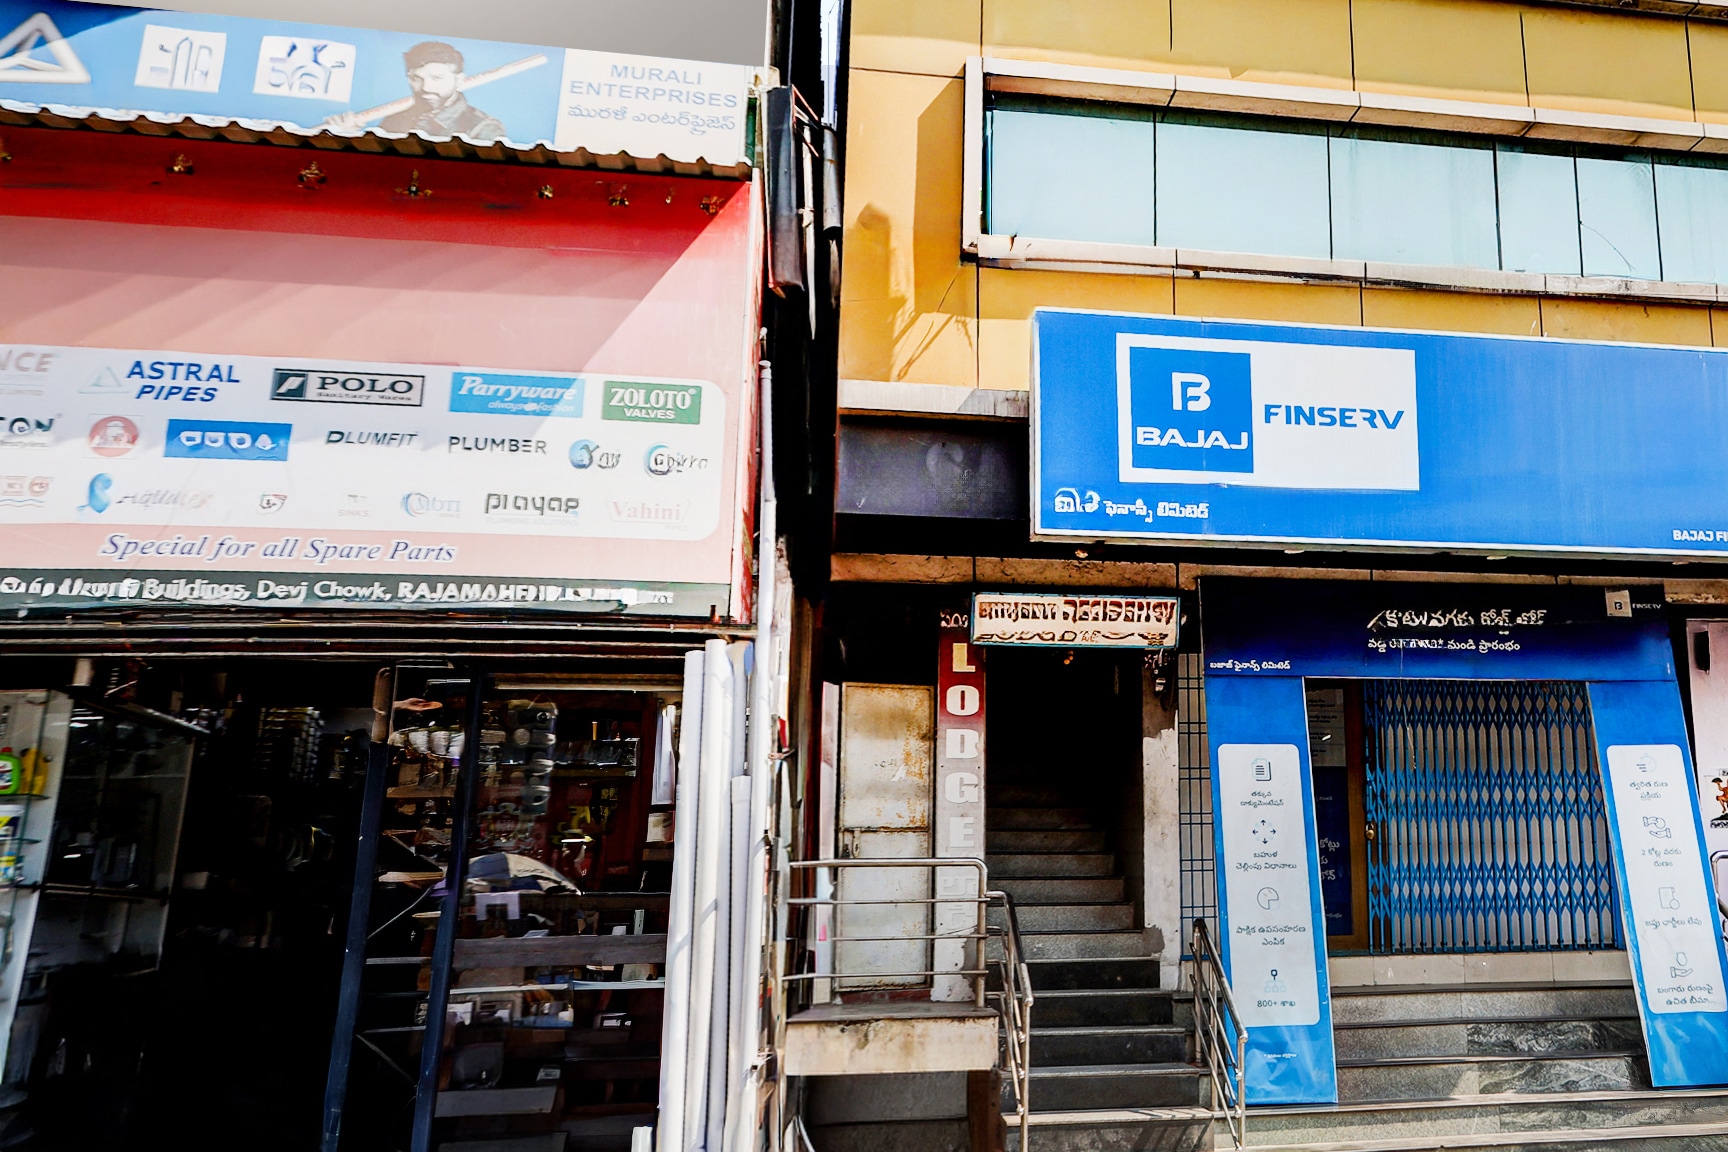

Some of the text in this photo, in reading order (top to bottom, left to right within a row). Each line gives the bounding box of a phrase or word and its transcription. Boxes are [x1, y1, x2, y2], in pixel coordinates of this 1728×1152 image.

[610, 64, 702, 85] MURALI
[569, 80, 737, 108] ENTERPRISES
[126, 360, 240, 383] ASTRAL
[135, 384, 218, 402] PIPES
[316, 375, 414, 394] POLO
[458, 375, 577, 401] Parryware
[609, 386, 692, 410] ZOLOTO
[624, 407, 676, 419] VALVES
[1264, 403, 1405, 430] FINSERV
[448, 435, 547, 454] PLUMBER
[1136, 426, 1249, 451] BAJAJ
[612, 500, 682, 521] Vahini
[1672, 529, 1714, 542] BAJAJ
[102, 533, 456, 563] Special for all Spare Parts
[314, 580, 392, 602] Chowk,
[1478, 638, 1521, 654] ప్రారంభం
[944, 642, 982, 848] LODGE
[1257, 1000, 1277, 1008] 800+
